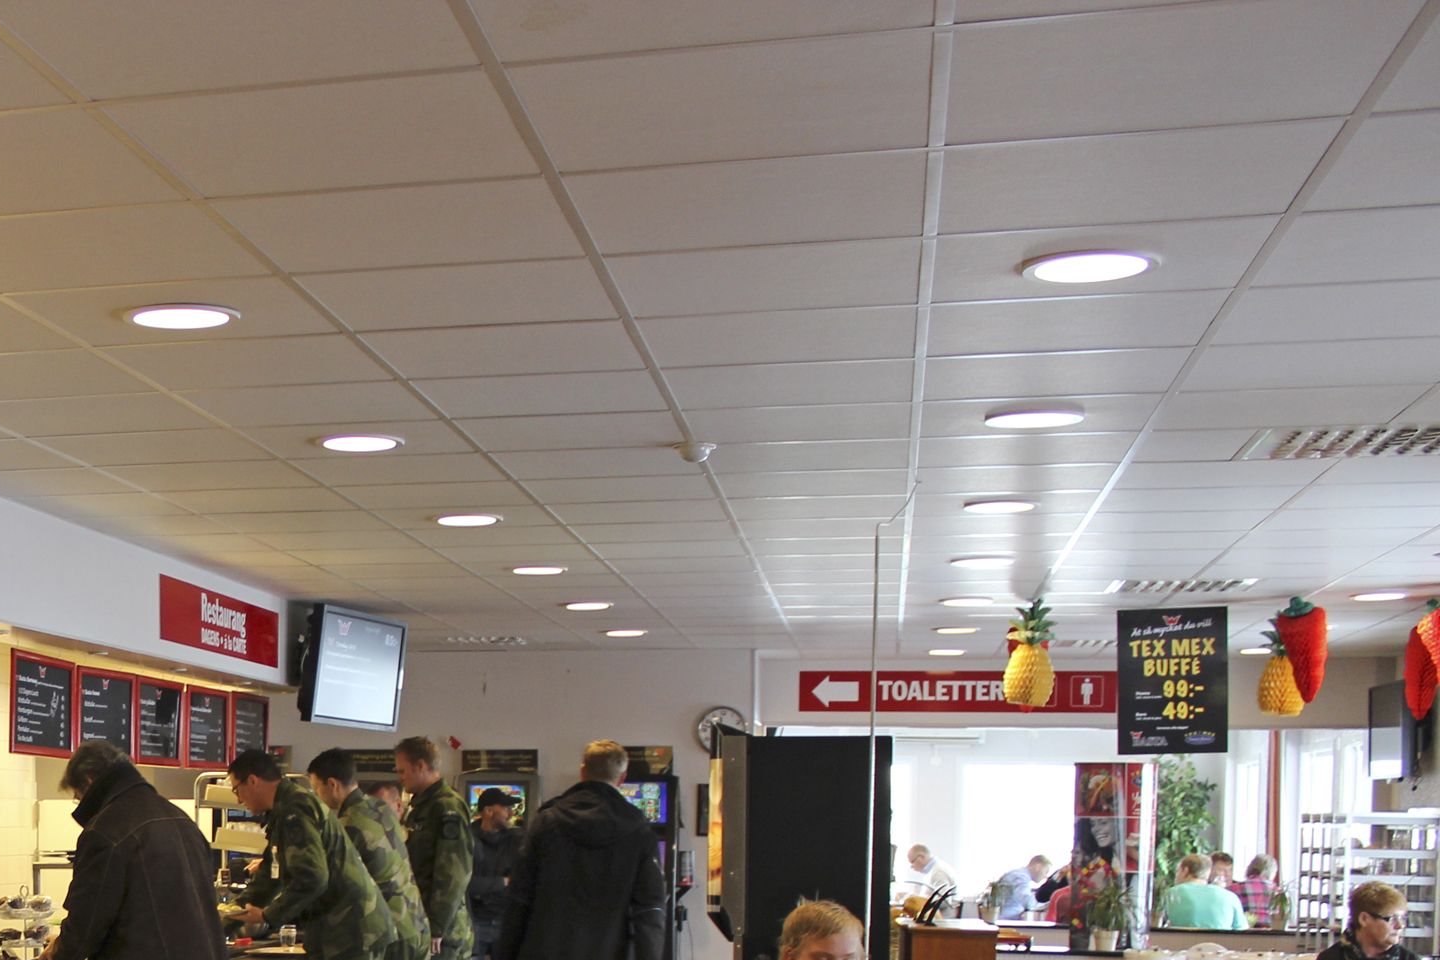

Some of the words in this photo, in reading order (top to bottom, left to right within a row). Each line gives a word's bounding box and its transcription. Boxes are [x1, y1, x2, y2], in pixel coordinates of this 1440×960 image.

[201, 592, 247, 638] Restaurang
[232, 636, 247, 655] CARTE
[1128, 638, 1166, 658] TEX
[1171, 637, 1217, 657] MEX
[1143, 657, 1201, 677] BUFFÉ
[878, 680, 1003, 702] TOALETTER
[1163, 679, 1205, 698] 99:-
[1162, 701, 1205, 720] 49:-
